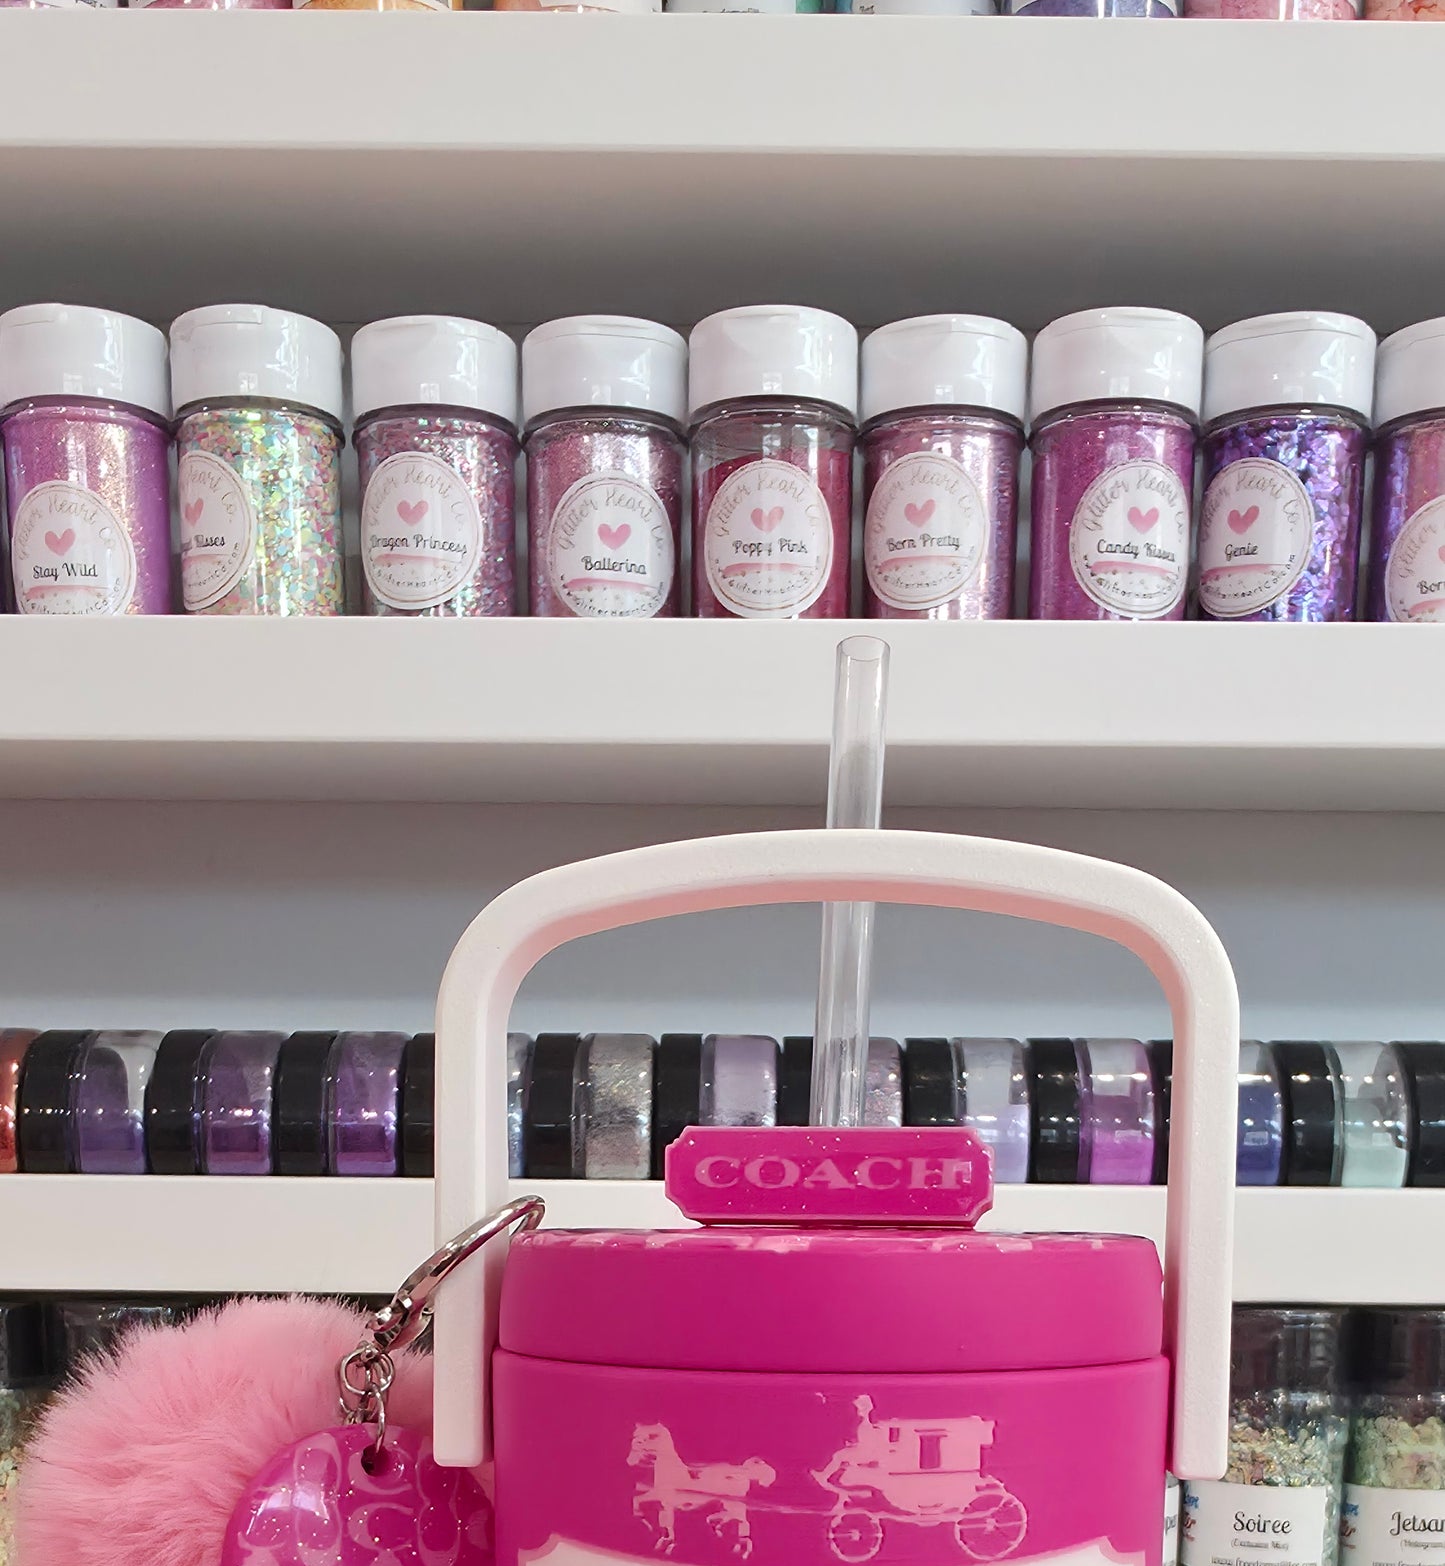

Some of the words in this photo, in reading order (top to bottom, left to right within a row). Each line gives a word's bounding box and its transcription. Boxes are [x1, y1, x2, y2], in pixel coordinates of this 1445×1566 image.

[369, 534, 410, 551] Dragon
[413, 534, 468, 558] Princess
[732, 539, 773, 558] Poppy
[777, 536, 808, 555] Pink
[886, 537, 917, 552] Born
[919, 532, 960, 552] Pretty
[1097, 538, 1140, 560] Candy
[1143, 541, 1176, 563] Kisses
[1224, 542, 1259, 562] Genie
[33, 565, 59, 581] Stay
[62, 562, 98, 578] Wild
[581, 555, 647, 575] Ballerina
[694, 1154, 971, 1191] COACH
[1232, 1510, 1293, 1535] Soiree
